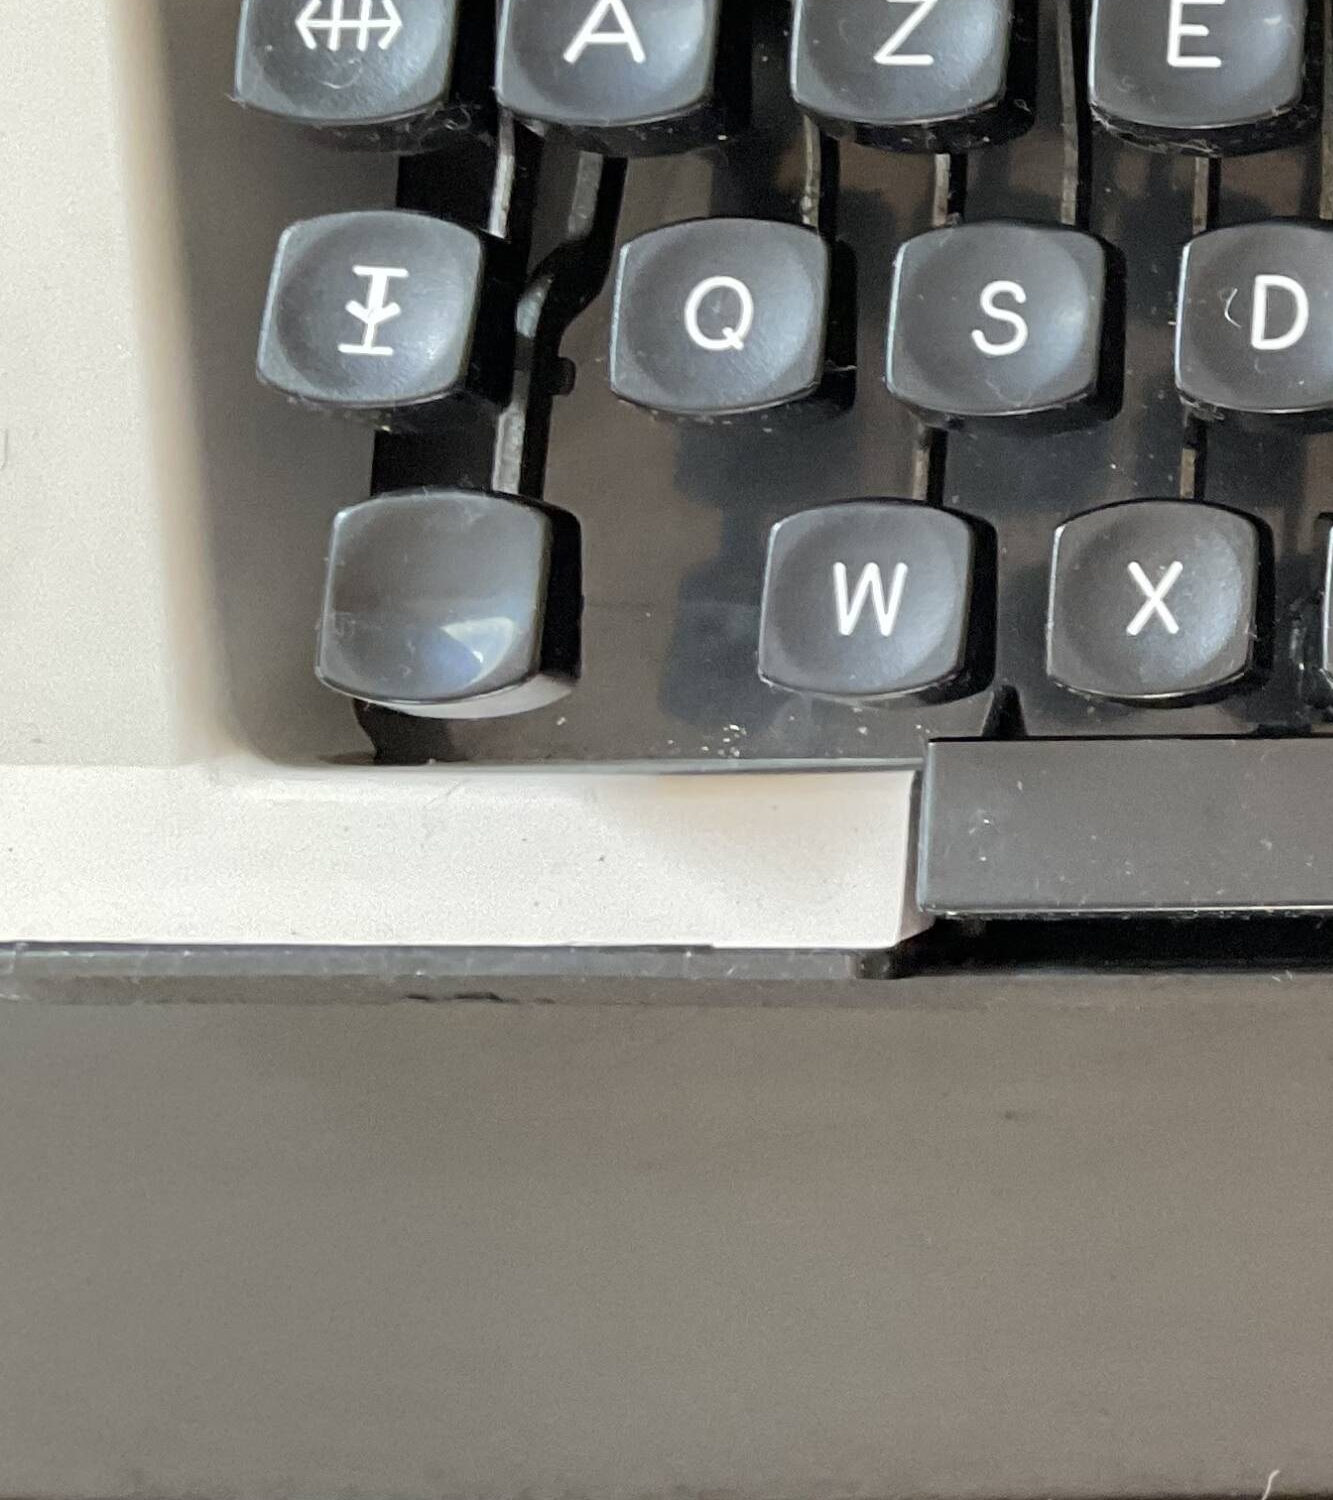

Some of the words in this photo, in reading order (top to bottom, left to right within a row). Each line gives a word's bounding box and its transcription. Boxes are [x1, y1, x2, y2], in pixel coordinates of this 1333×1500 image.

[684, 276, 754, 351] Q
[971, 280, 1028, 356] S
[1249, 274, 1309, 350] D
[833, 562, 908, 637] W
[1126, 561, 1184, 636] X
